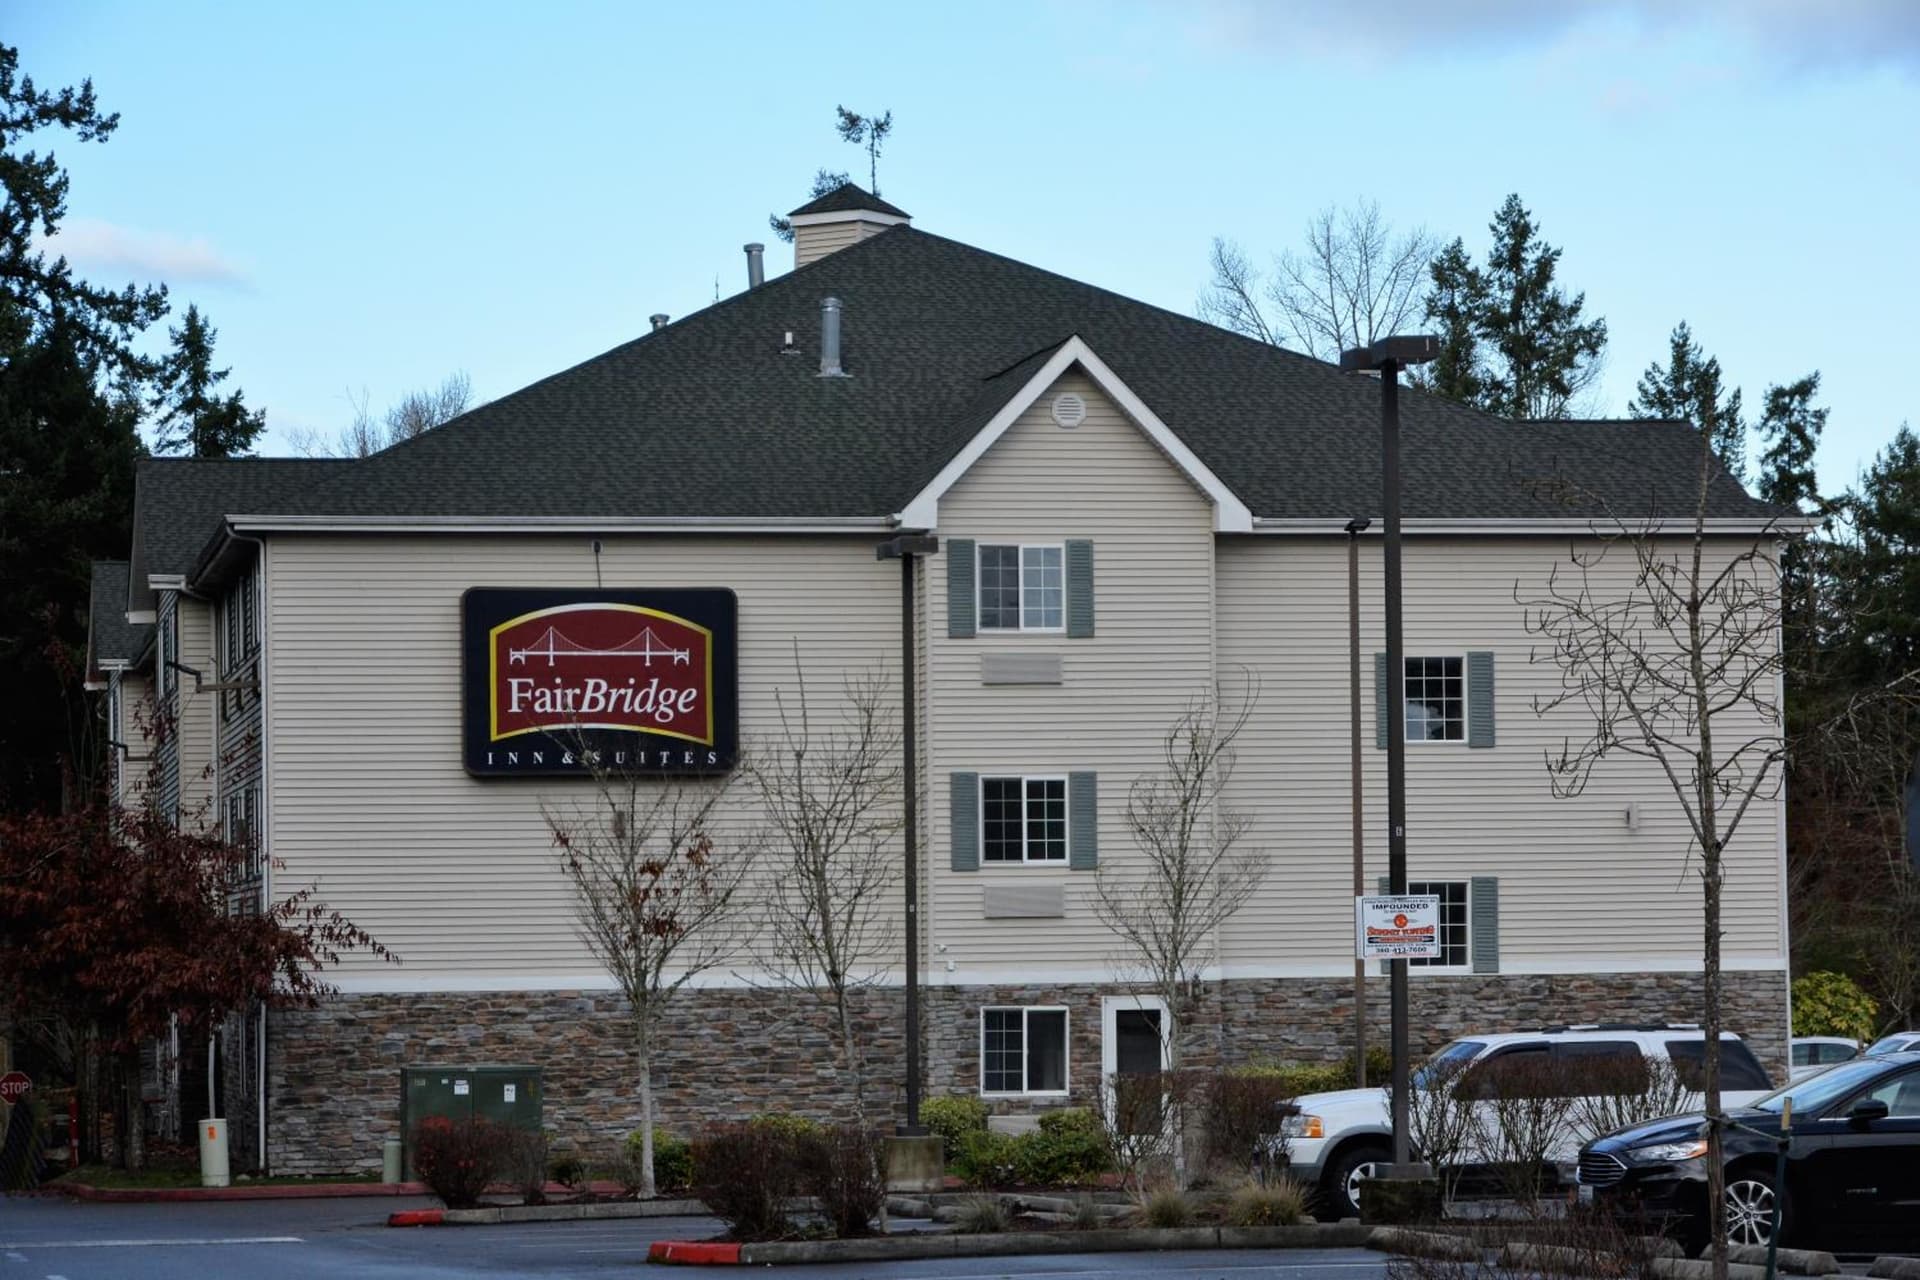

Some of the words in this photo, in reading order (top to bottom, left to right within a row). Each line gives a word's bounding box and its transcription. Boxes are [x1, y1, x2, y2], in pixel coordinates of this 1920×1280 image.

[507, 677, 698, 723] FairBridge
[487, 752, 544, 765] INN
[561, 751, 575, 765] &
[592, 751, 717, 765] SUITES
[1, 1082, 29, 1095] STOP
